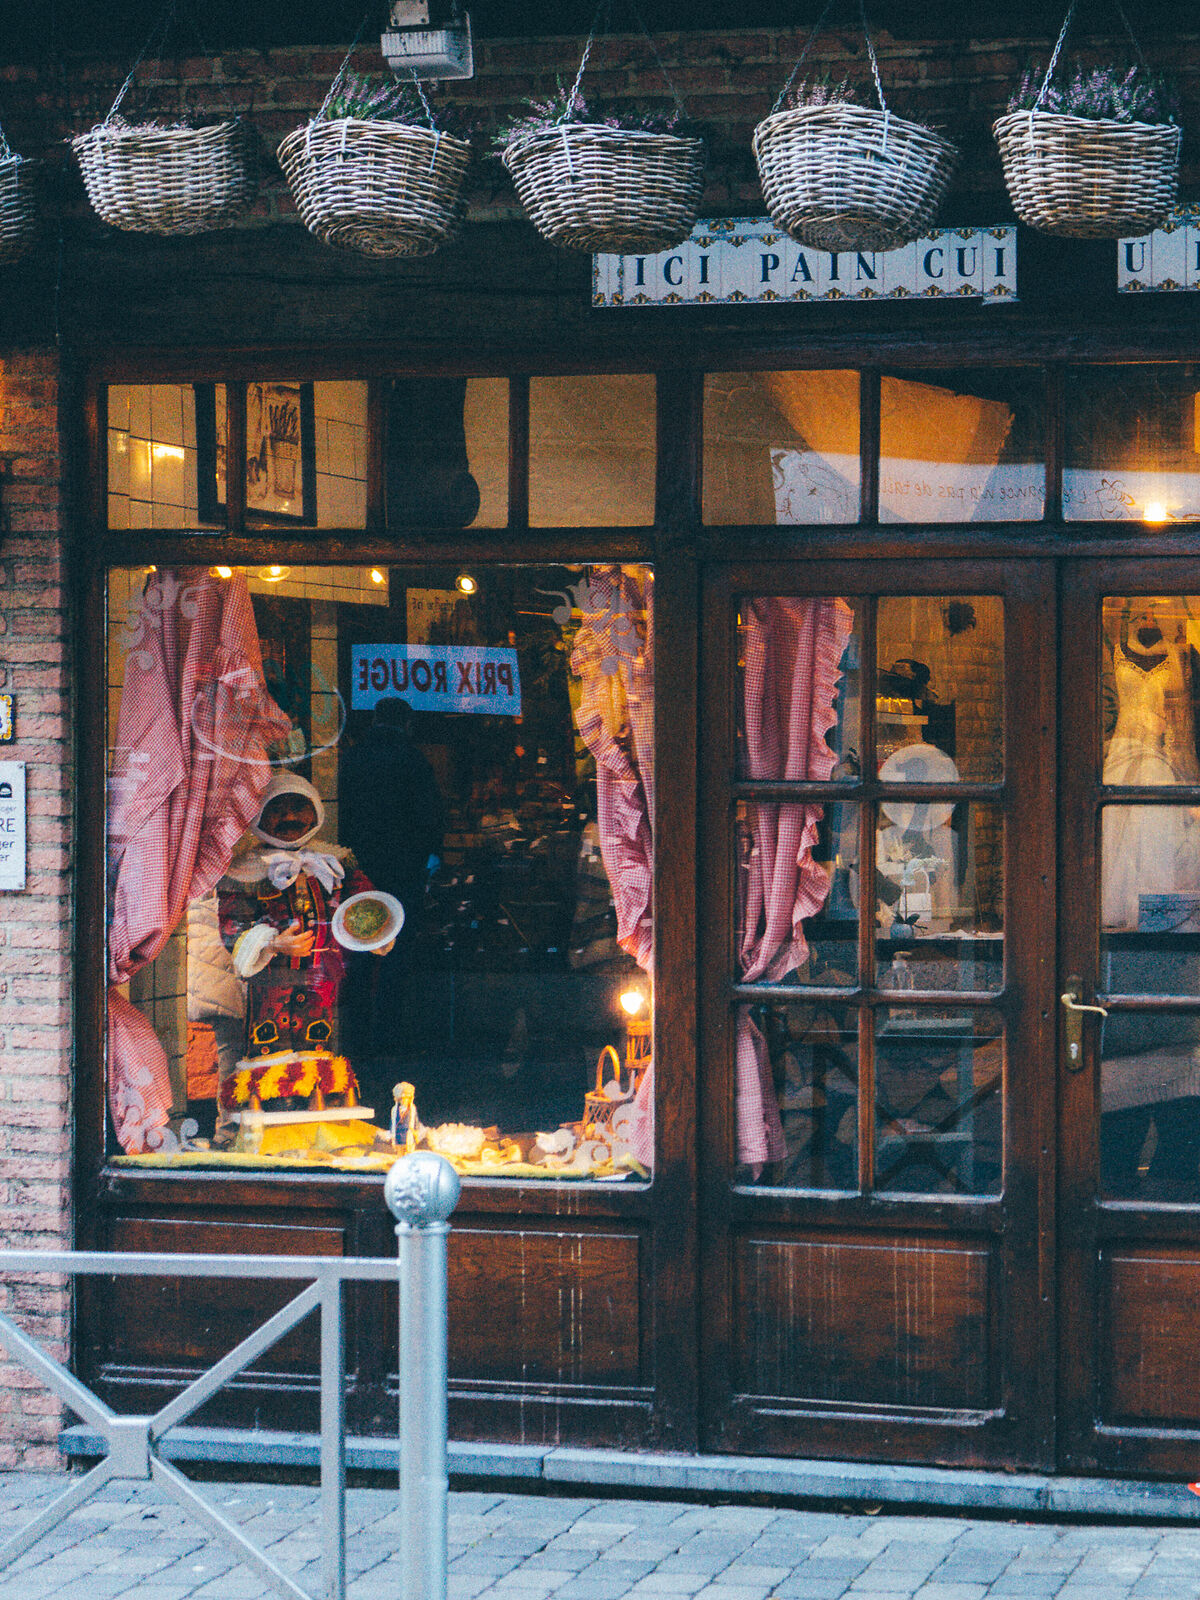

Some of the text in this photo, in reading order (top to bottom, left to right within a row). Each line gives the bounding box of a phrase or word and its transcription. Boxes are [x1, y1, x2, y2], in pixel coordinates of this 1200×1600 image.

[634, 246, 1007, 287] ICI PAIN CUI
[1124, 241, 1147, 273] U
